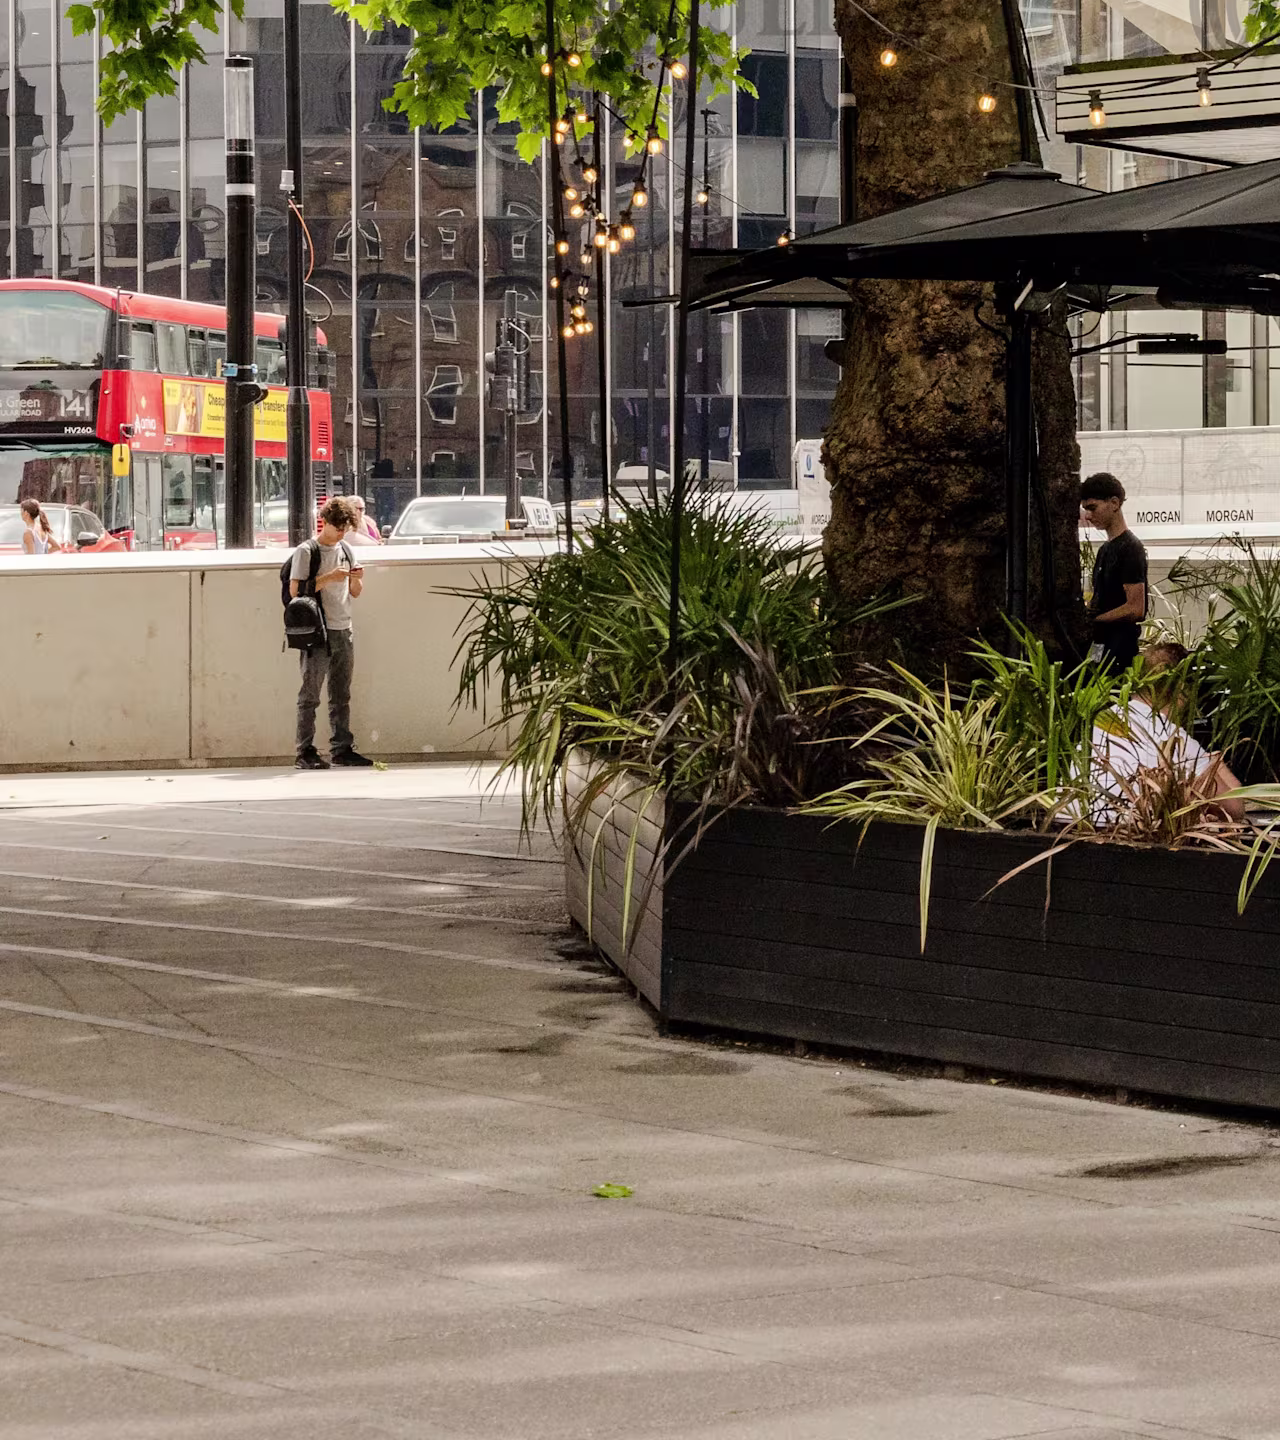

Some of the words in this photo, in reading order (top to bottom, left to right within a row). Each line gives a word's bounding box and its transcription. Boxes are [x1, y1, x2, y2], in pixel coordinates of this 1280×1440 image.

[6, 395, 41, 409] Green
[60, 396, 91, 417] 141
[20, 409, 42, 417] ROAD
[1136, 510, 1181, 523] MORGAN
[1206, 509, 1254, 523] MORGAN
